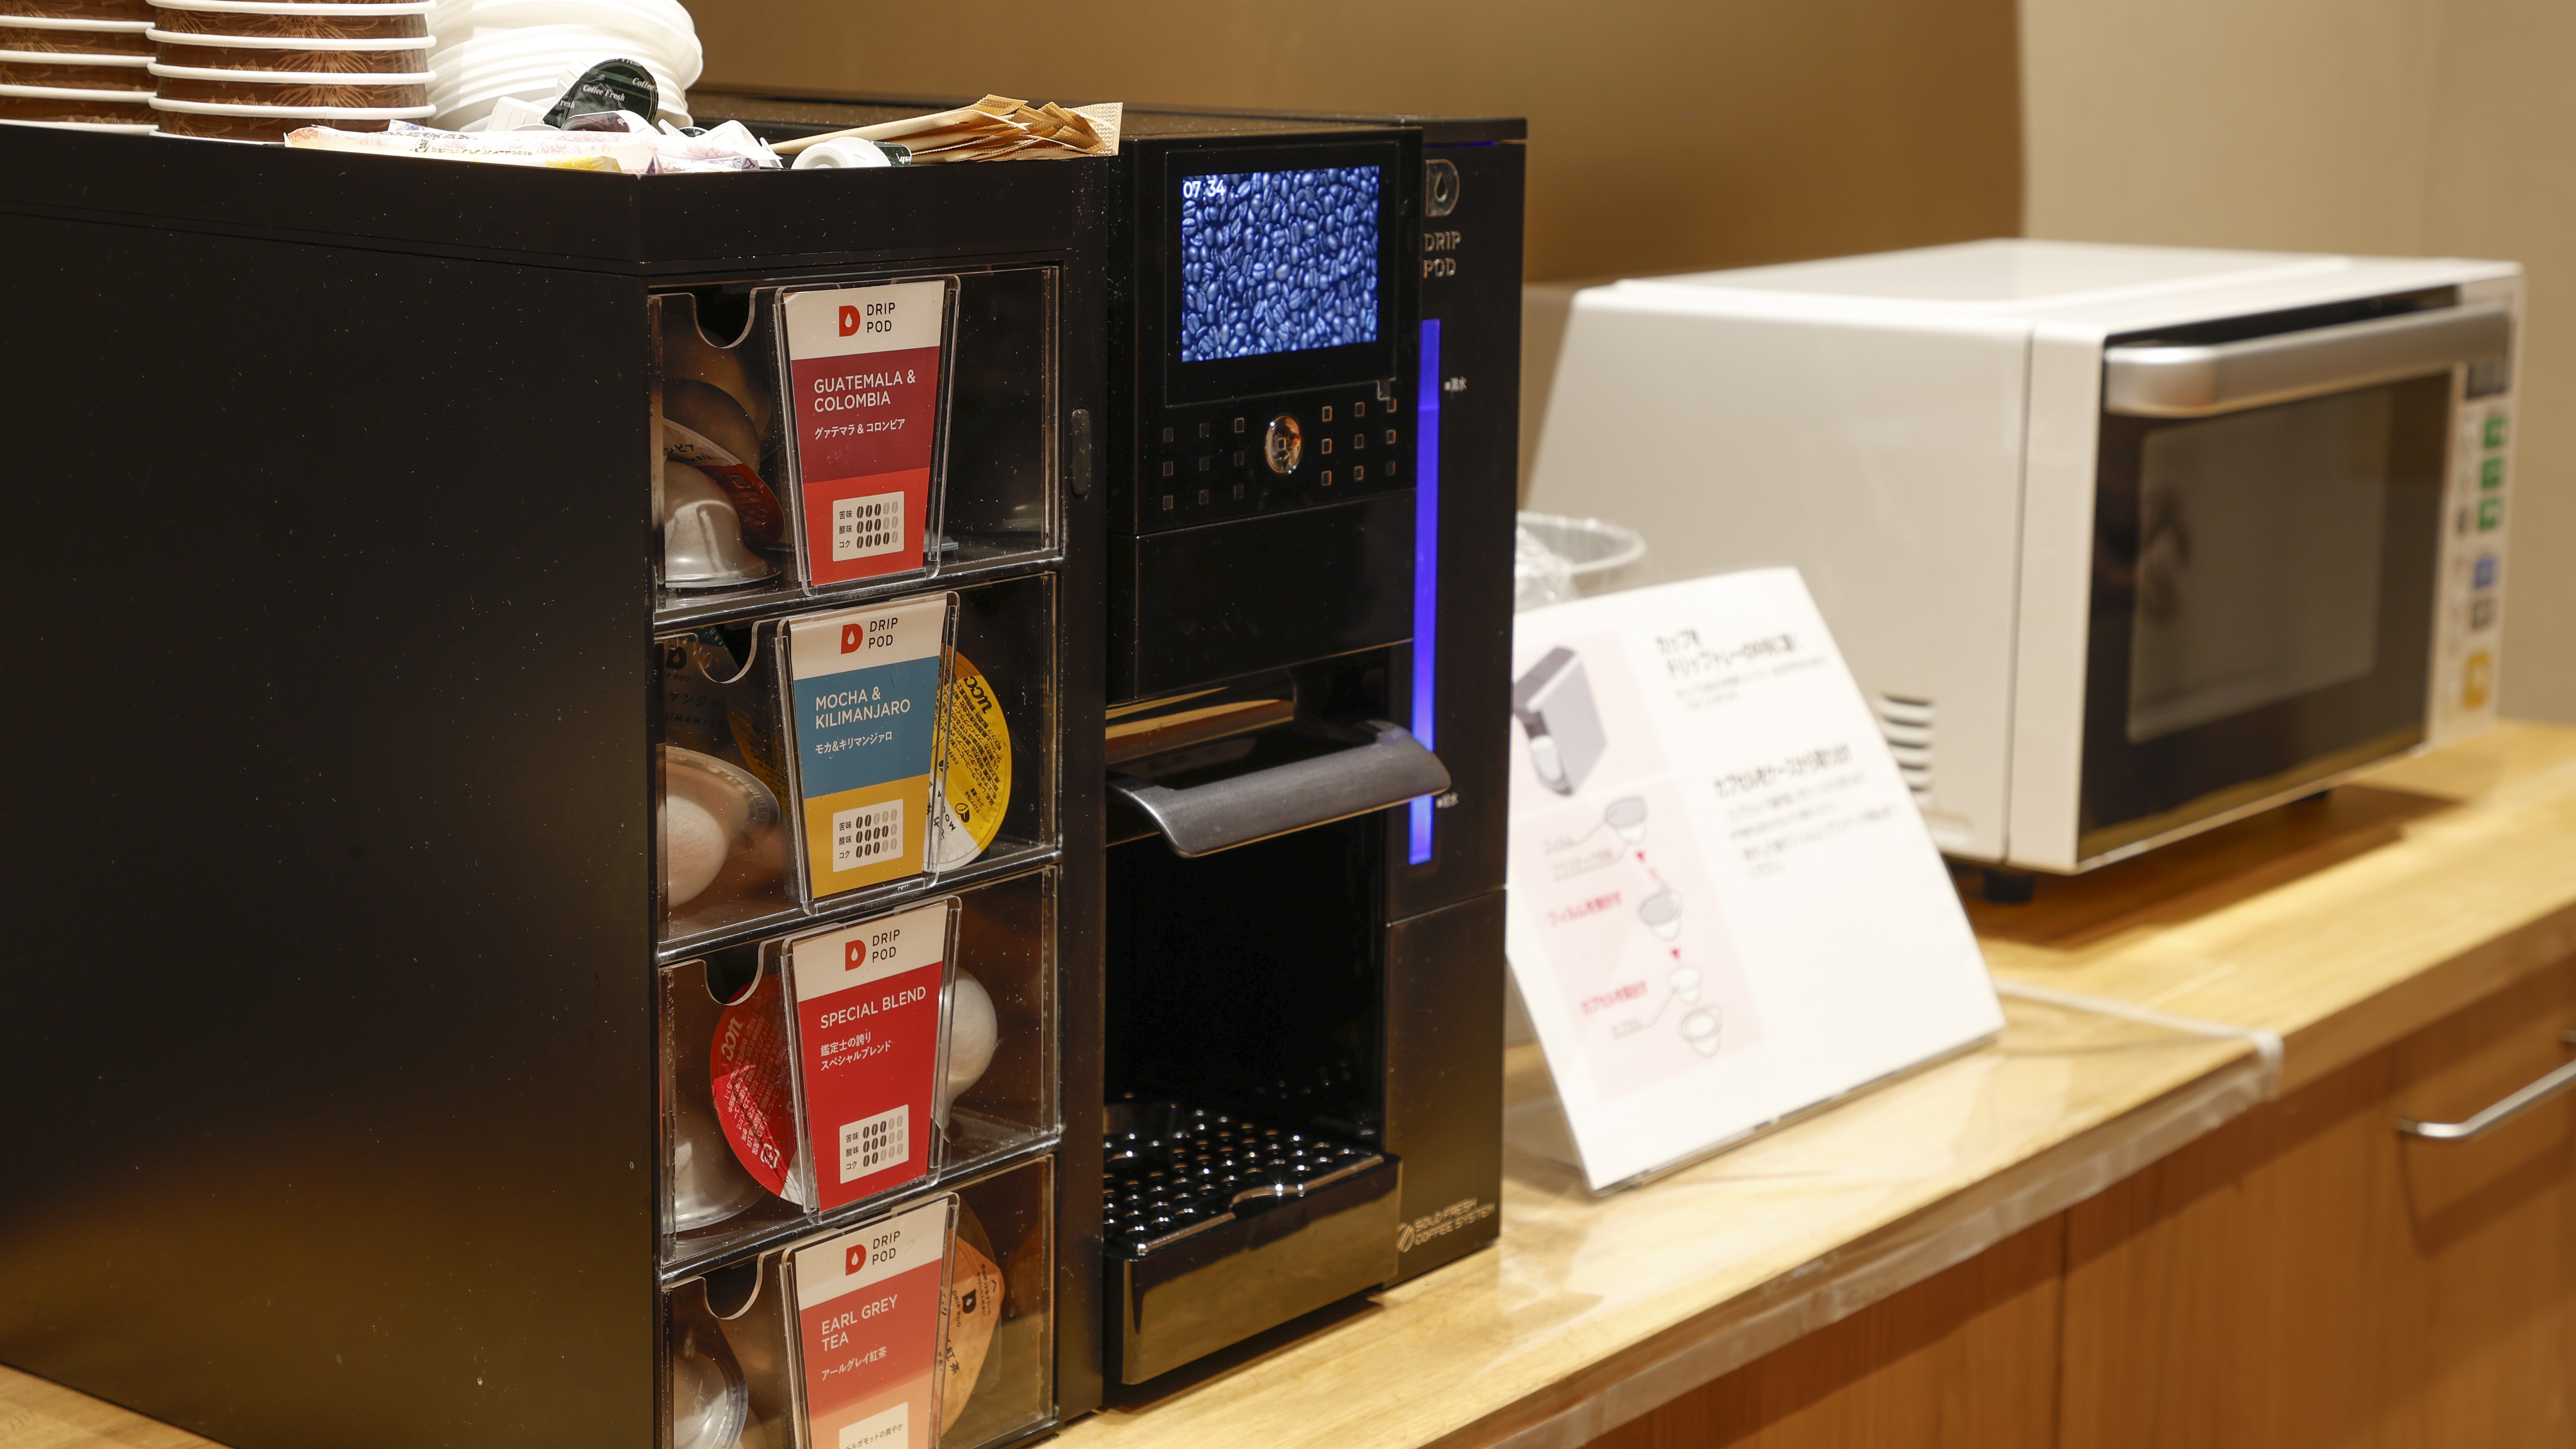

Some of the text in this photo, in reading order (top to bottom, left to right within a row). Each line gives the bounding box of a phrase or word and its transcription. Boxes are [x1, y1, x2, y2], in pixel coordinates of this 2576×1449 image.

[583, 84, 625, 102] Coffee Fresh
[1424, 231, 1461, 252] DRIP
[1423, 258, 1456, 279] POD
[867, 302, 895, 316] DRIP
[867, 320, 892, 333] POD
[814, 369, 916, 394] GUATEMALA &
[814, 391, 891, 413] COLOMBIA
[814, 419, 905, 440] グァテマラ & コロンビア
[838, 510, 853, 520] 苦味
[838, 524, 853, 535] 酸味
[839, 539, 851, 549] コク
[869, 617, 898, 632] DRIP
[868, 634, 893, 649] POD
[816, 686, 881, 711] MOCHA &
[816, 699, 911, 729] KILIMANJARO
[838, 821, 852, 831] 苦味
[838, 835, 852, 846] 酸味
[839, 850, 850, 859] コク
[872, 929, 900, 947] DRIP
[872, 946, 896, 963] POD
[820, 986, 926, 1029] SPECIAL BLEND
[820, 1031, 871, 1057] 鑑定士の誇り
[821, 1039, 892, 1071] スペシャルブレンド
[845, 1132, 859, 1143] 苦味
[846, 1146, 859, 1157] 酸味
[846, 1161, 857, 1170] コク
[873, 1230, 900, 1250] DRIP
[872, 1248, 896, 1266] POD
[822, 1294, 898, 1335] EARL GREY
[822, 1331, 849, 1352] TEA
[822, 1346, 887, 1381] アールグレイ紅茶
